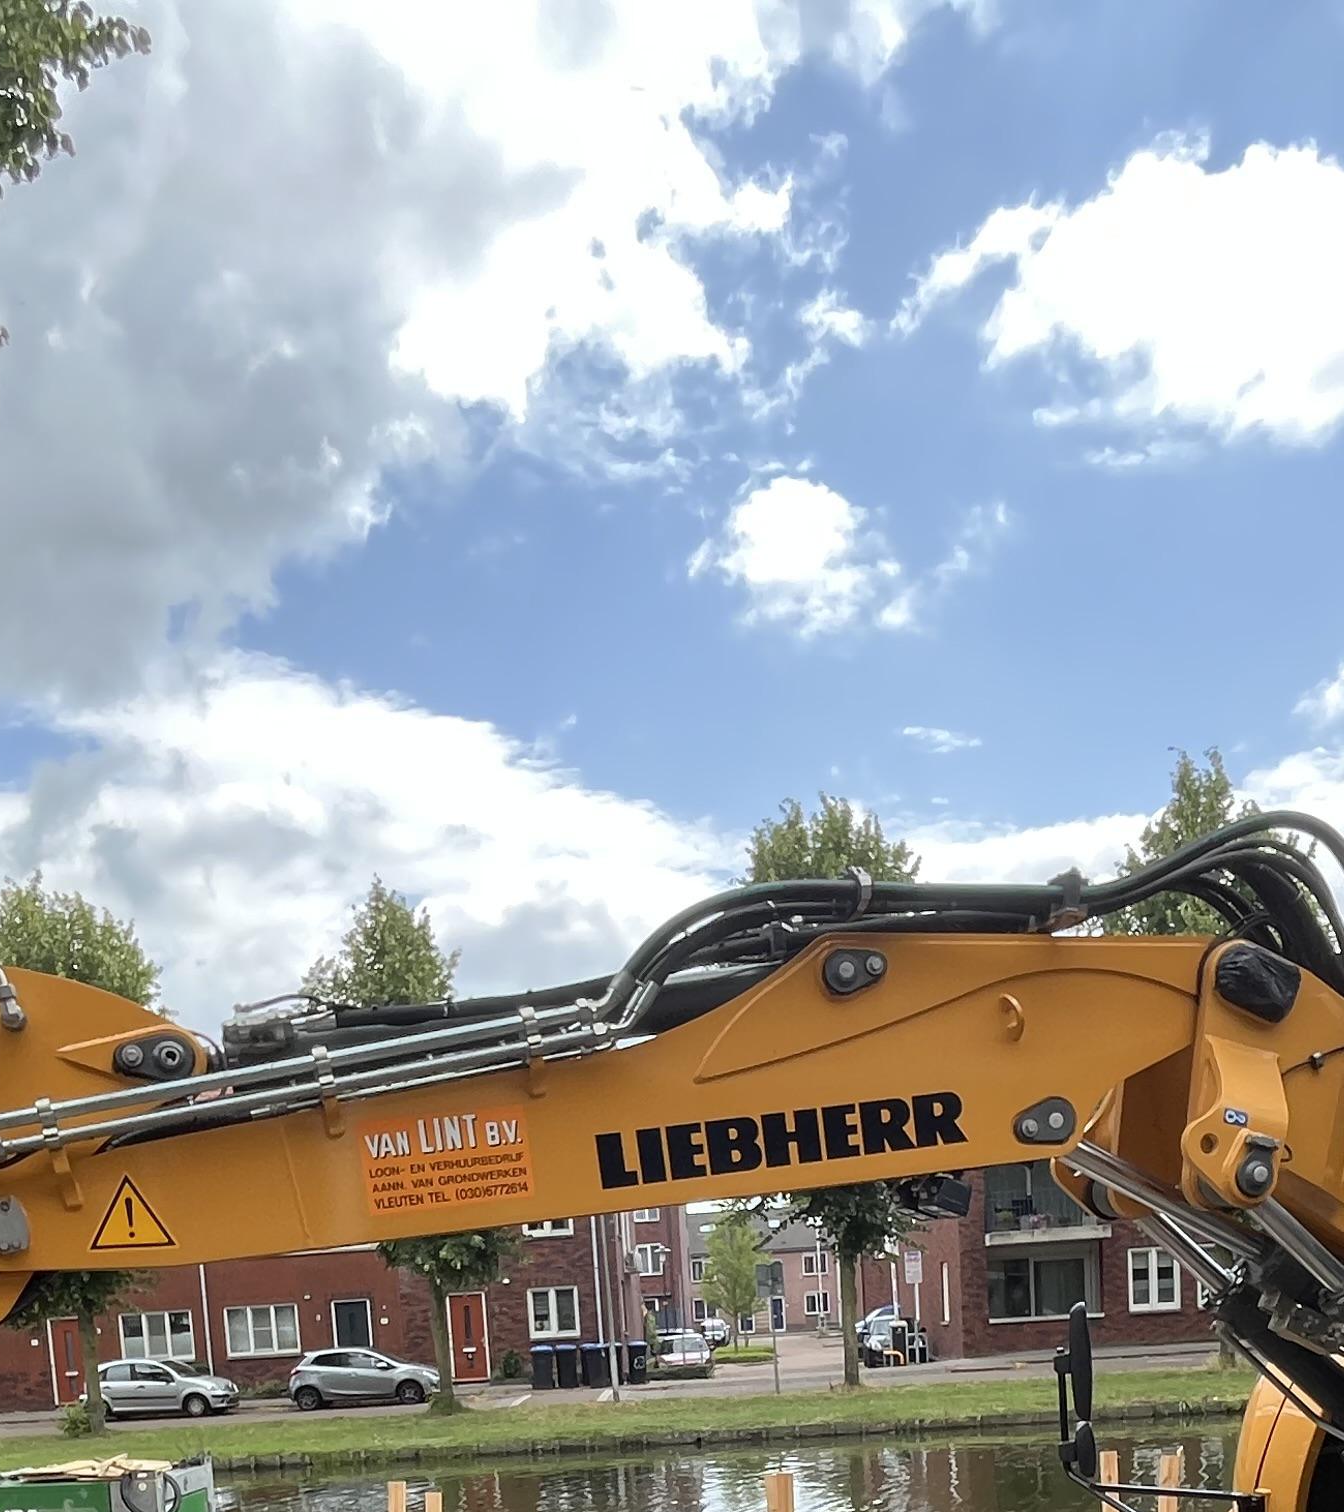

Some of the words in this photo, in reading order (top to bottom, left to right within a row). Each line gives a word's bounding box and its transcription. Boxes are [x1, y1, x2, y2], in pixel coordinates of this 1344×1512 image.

[364, 1131, 411, 1160] VAN
[417, 1114, 476, 1155] LINT
[485, 1119, 524, 1148] B.V.
[595, 1091, 969, 1190] LIEBHERR
[369, 1165, 406, 1179] LOON-
[410, 1163, 426, 1175] EN
[430, 1151, 525, 1172] VERHUURBEDRIJF
[411, 1176, 434, 1190] VAN
[438, 1167, 528, 1186] GRONDWERKEN
[374, 1193, 425, 1211] VLEUTEN
